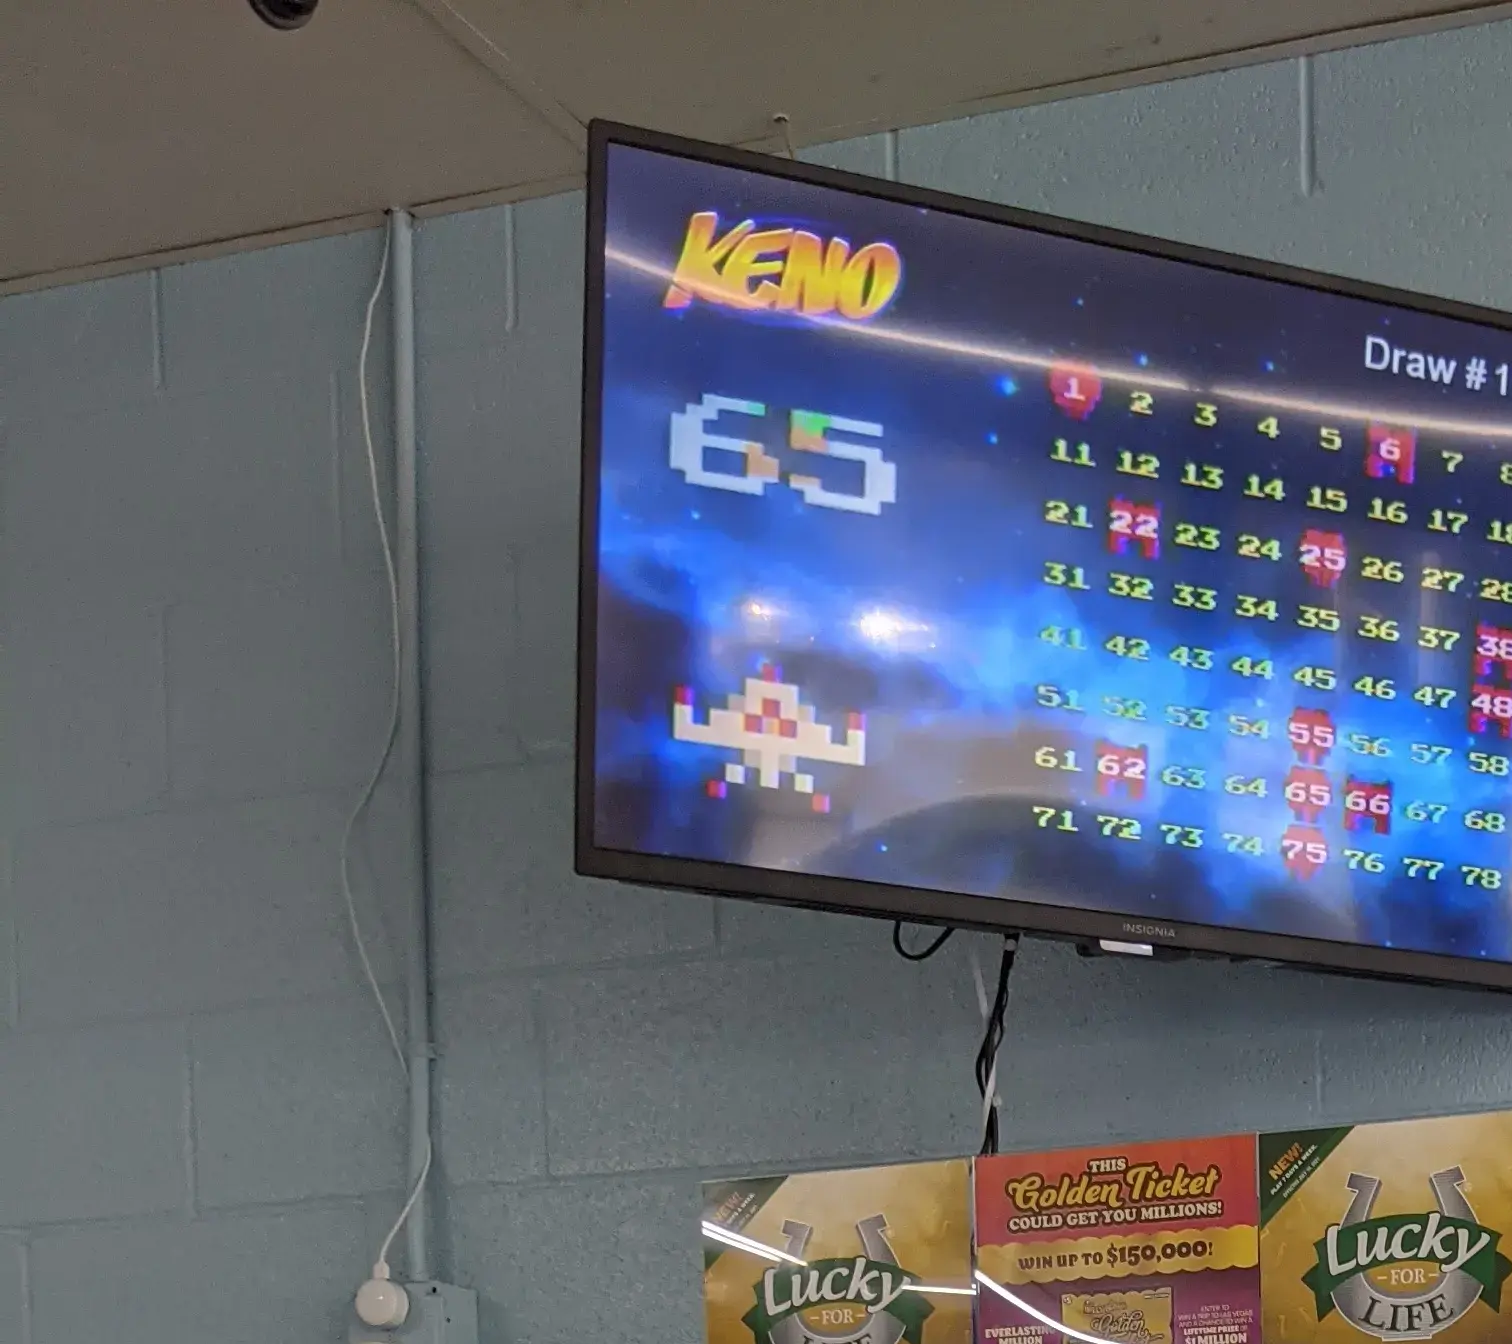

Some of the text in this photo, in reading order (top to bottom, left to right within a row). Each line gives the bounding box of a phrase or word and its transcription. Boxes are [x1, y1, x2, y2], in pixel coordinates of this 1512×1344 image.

[662, 211, 903, 319] KENO
[1365, 335, 1457, 384] Draw
[1465, 359, 1487, 390] #
[667, 392, 897, 515] 65
[1050, 439, 1096, 467] 11
[1116, 451, 1160, 478] 12
[1181, 463, 1223, 489] 13
[1244, 474, 1286, 501] 14
[1307, 487, 1347, 512] 15
[1368, 498, 1408, 524] 16
[1428, 509, 1468, 533] 17
[1123, 922, 1175, 938] INSIGNIA
[1268, 1142, 1304, 1180] NEW!
[1325, 1212, 1490, 1276] Lucky
[1390, 1268, 1426, 1285] FOR
[1358, 1292, 1454, 1333] LIFE
